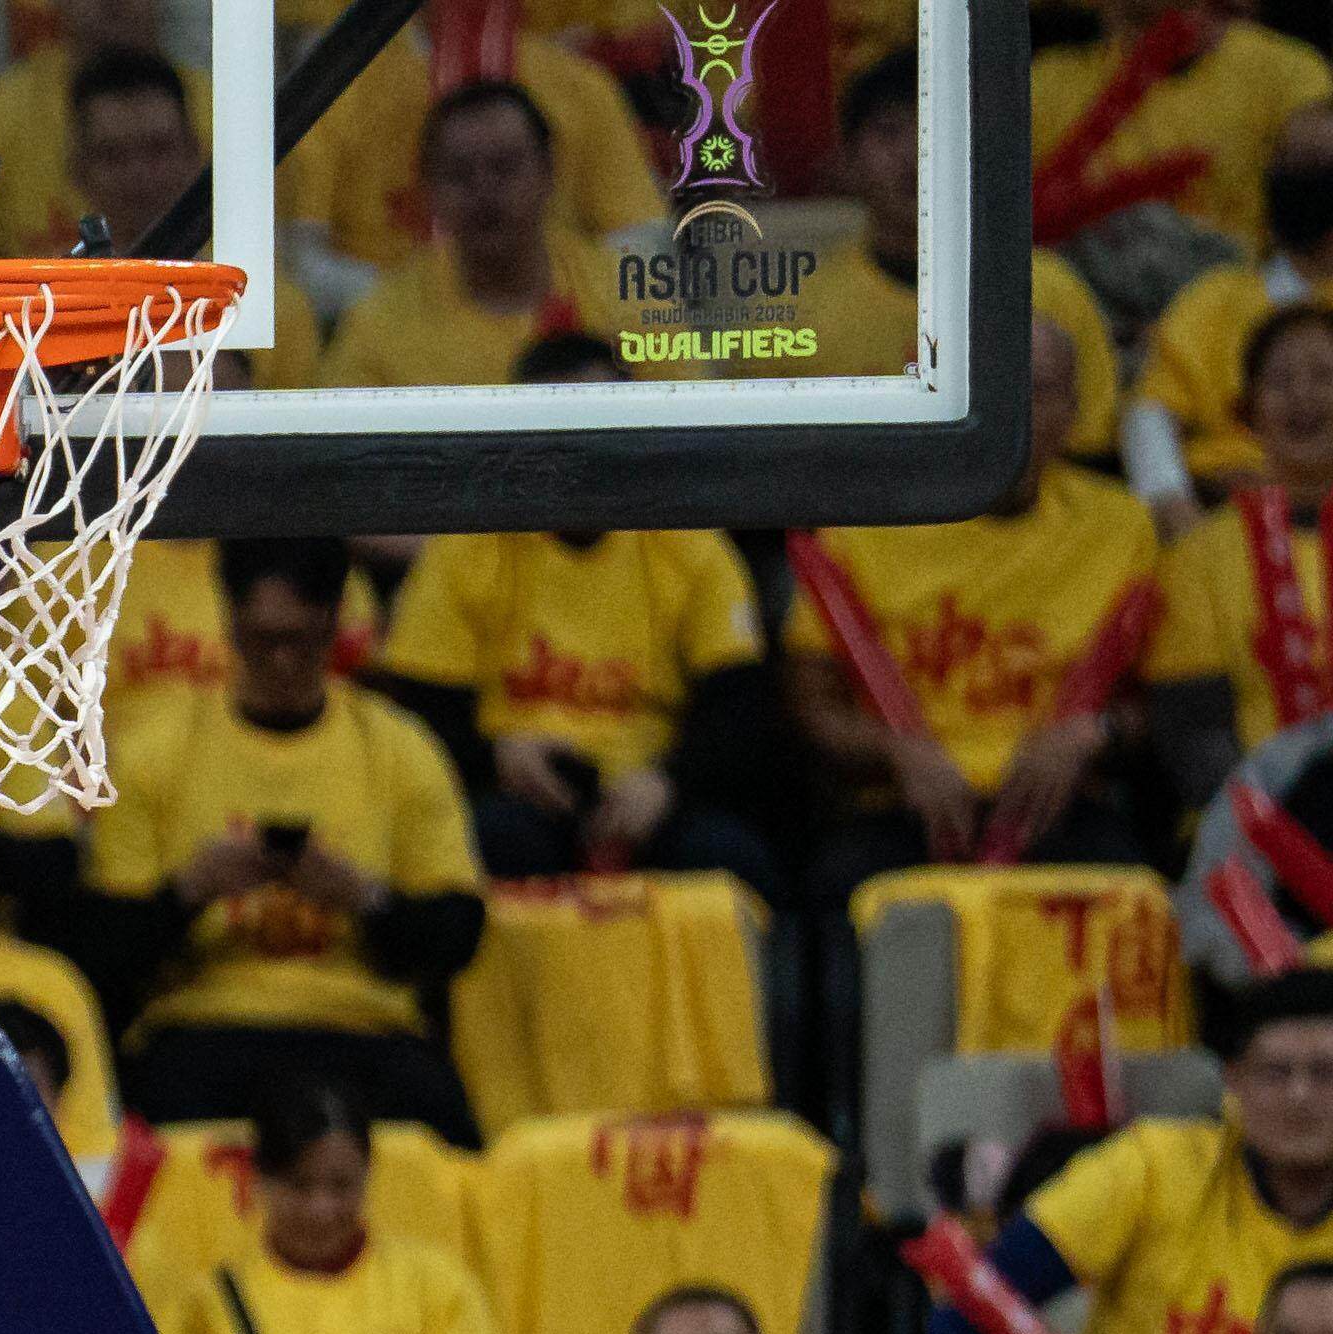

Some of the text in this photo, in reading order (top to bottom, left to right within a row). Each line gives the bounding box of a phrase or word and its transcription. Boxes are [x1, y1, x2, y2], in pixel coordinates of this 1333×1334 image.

[619, 249, 817, 301] ASIA CUP
[619, 326, 819, 363] QUALIFIERS
